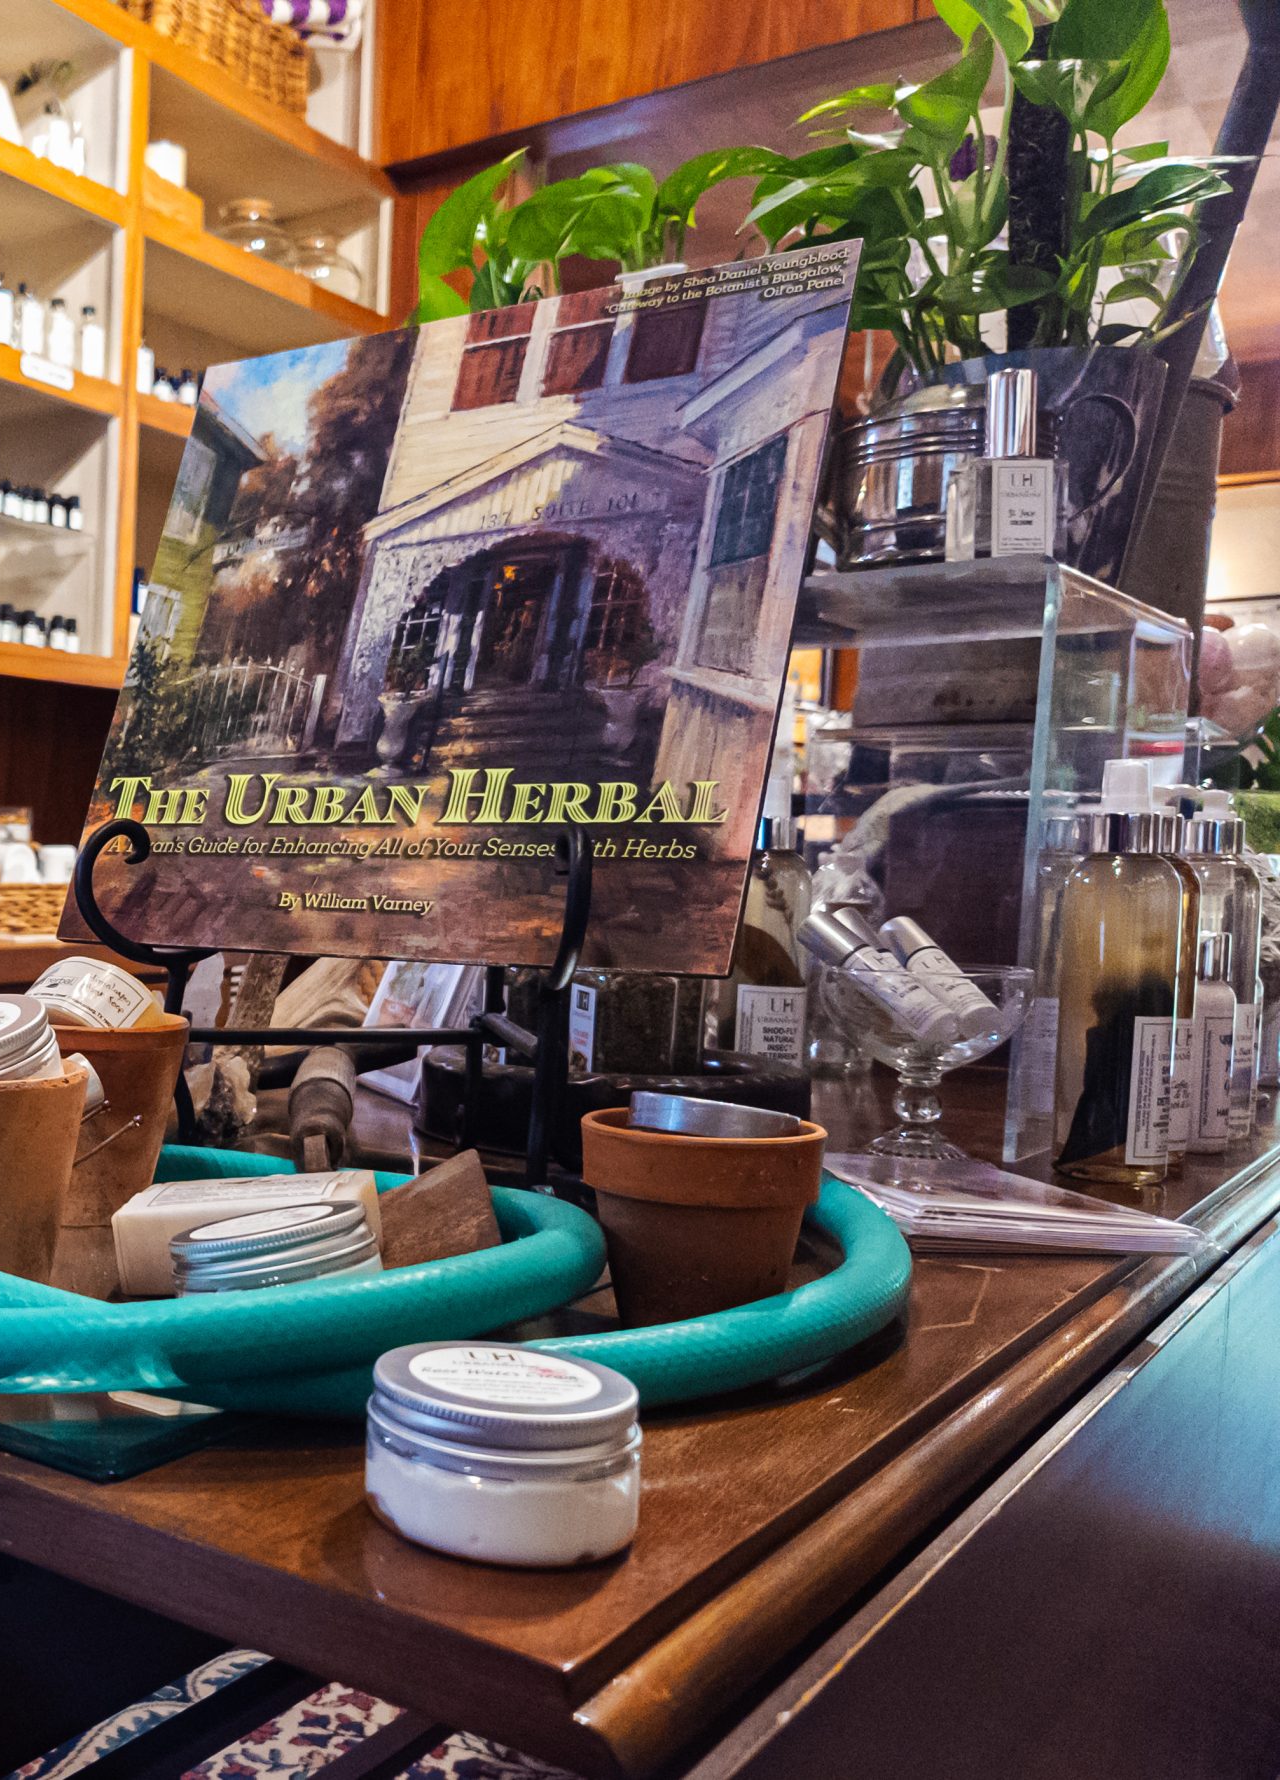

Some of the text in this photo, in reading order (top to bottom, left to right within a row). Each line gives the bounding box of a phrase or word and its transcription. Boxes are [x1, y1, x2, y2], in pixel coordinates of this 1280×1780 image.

[664, 281, 681, 293] by
[683, 274, 716, 288] Shea
[667, 294, 679, 303] to
[682, 289, 702, 300] the
[763, 274, 847, 298] Oil on Panel
[479, 511, 511, 531] 137
[608, 492, 639, 512] 101
[109, 767, 729, 826] THE URBAN HERBAL
[108, 839, 122, 853] A
[188, 837, 238, 854] Guide
[241, 836, 269, 855] for
[268, 837, 373, 862] Enhancing
[375, 837, 405, 856] All
[407, 836, 433, 857] of
[434, 837, 481, 857] Your
[624, 838, 697, 859] Herbs
[278, 891, 435, 916] By William Varney
